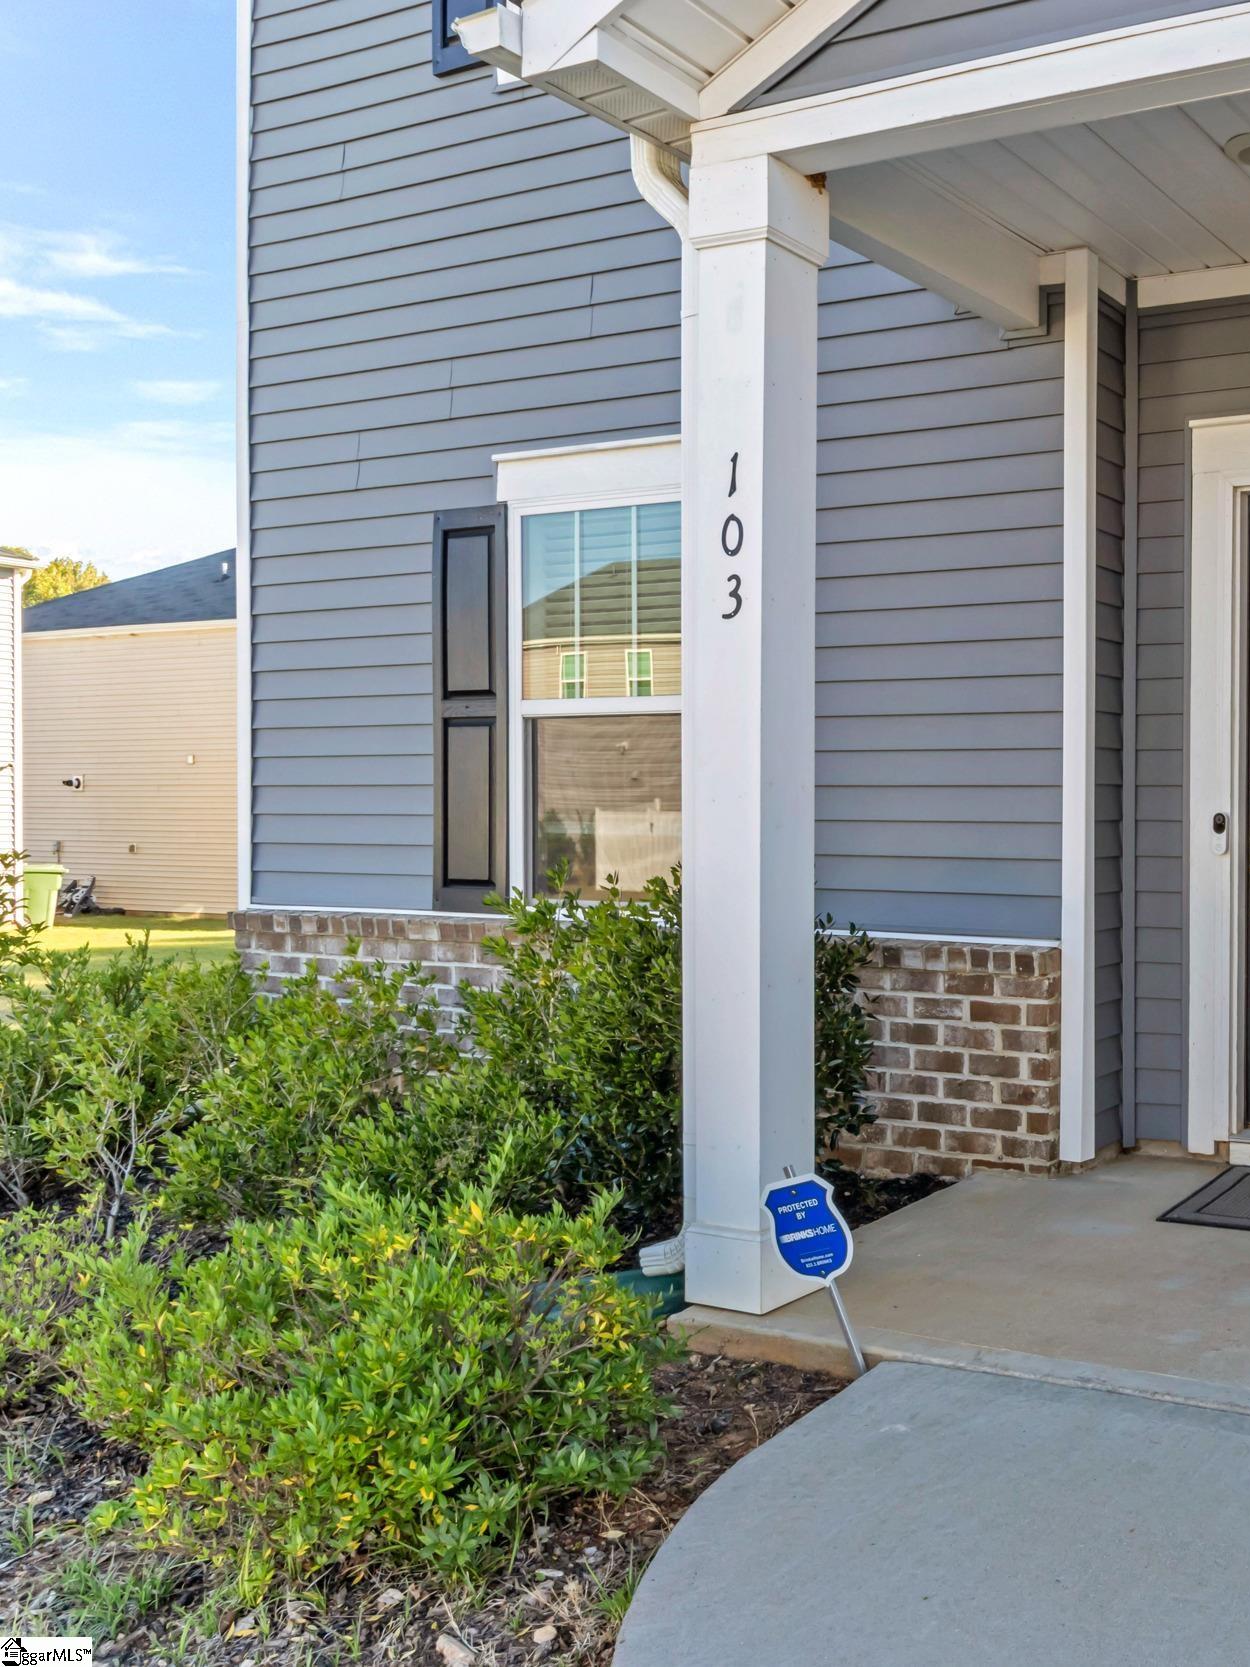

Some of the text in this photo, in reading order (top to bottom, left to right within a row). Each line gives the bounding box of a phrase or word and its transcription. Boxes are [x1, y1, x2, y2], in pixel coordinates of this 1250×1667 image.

[721, 452, 744, 620] 103
[778, 1198, 819, 1214] PROTECTED
[795, 1212, 806, 1220] BY
